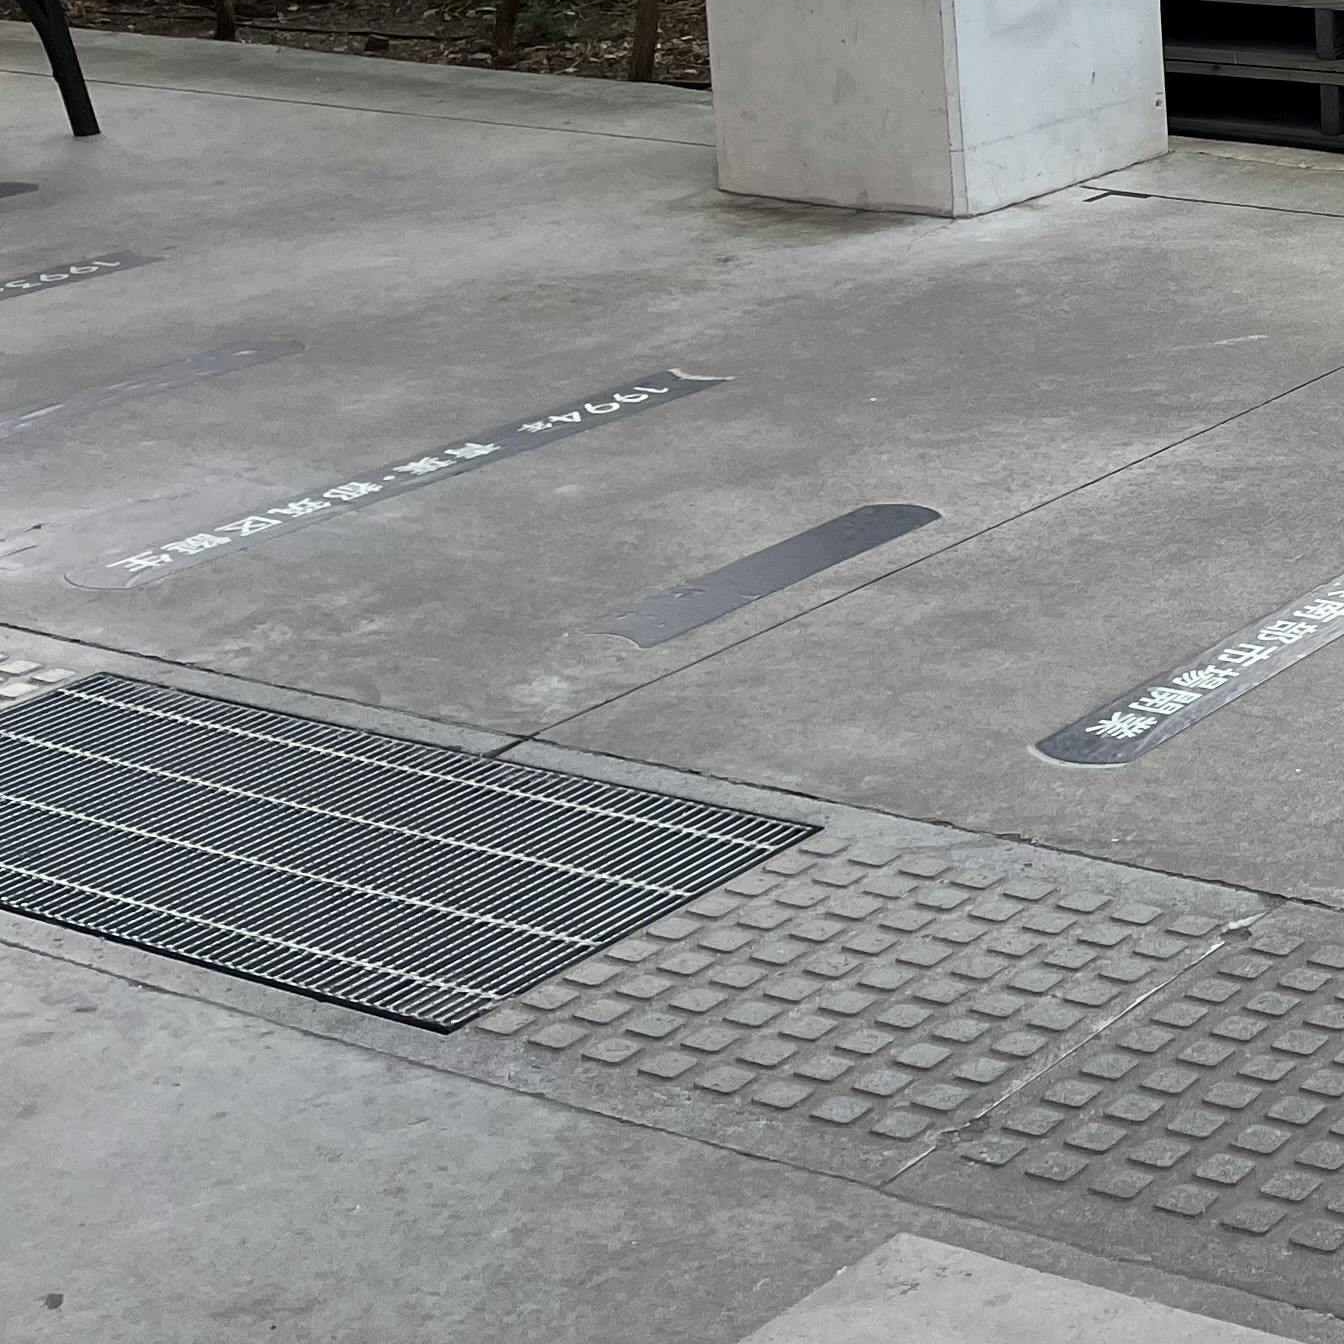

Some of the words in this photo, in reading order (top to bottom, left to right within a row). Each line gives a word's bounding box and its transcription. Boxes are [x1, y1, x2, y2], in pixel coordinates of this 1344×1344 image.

[0, 261, 120, 291] 1993
[517, 385, 669, 433] 1994年
[106, 442, 501, 573] 青葉・都筑区誕生
